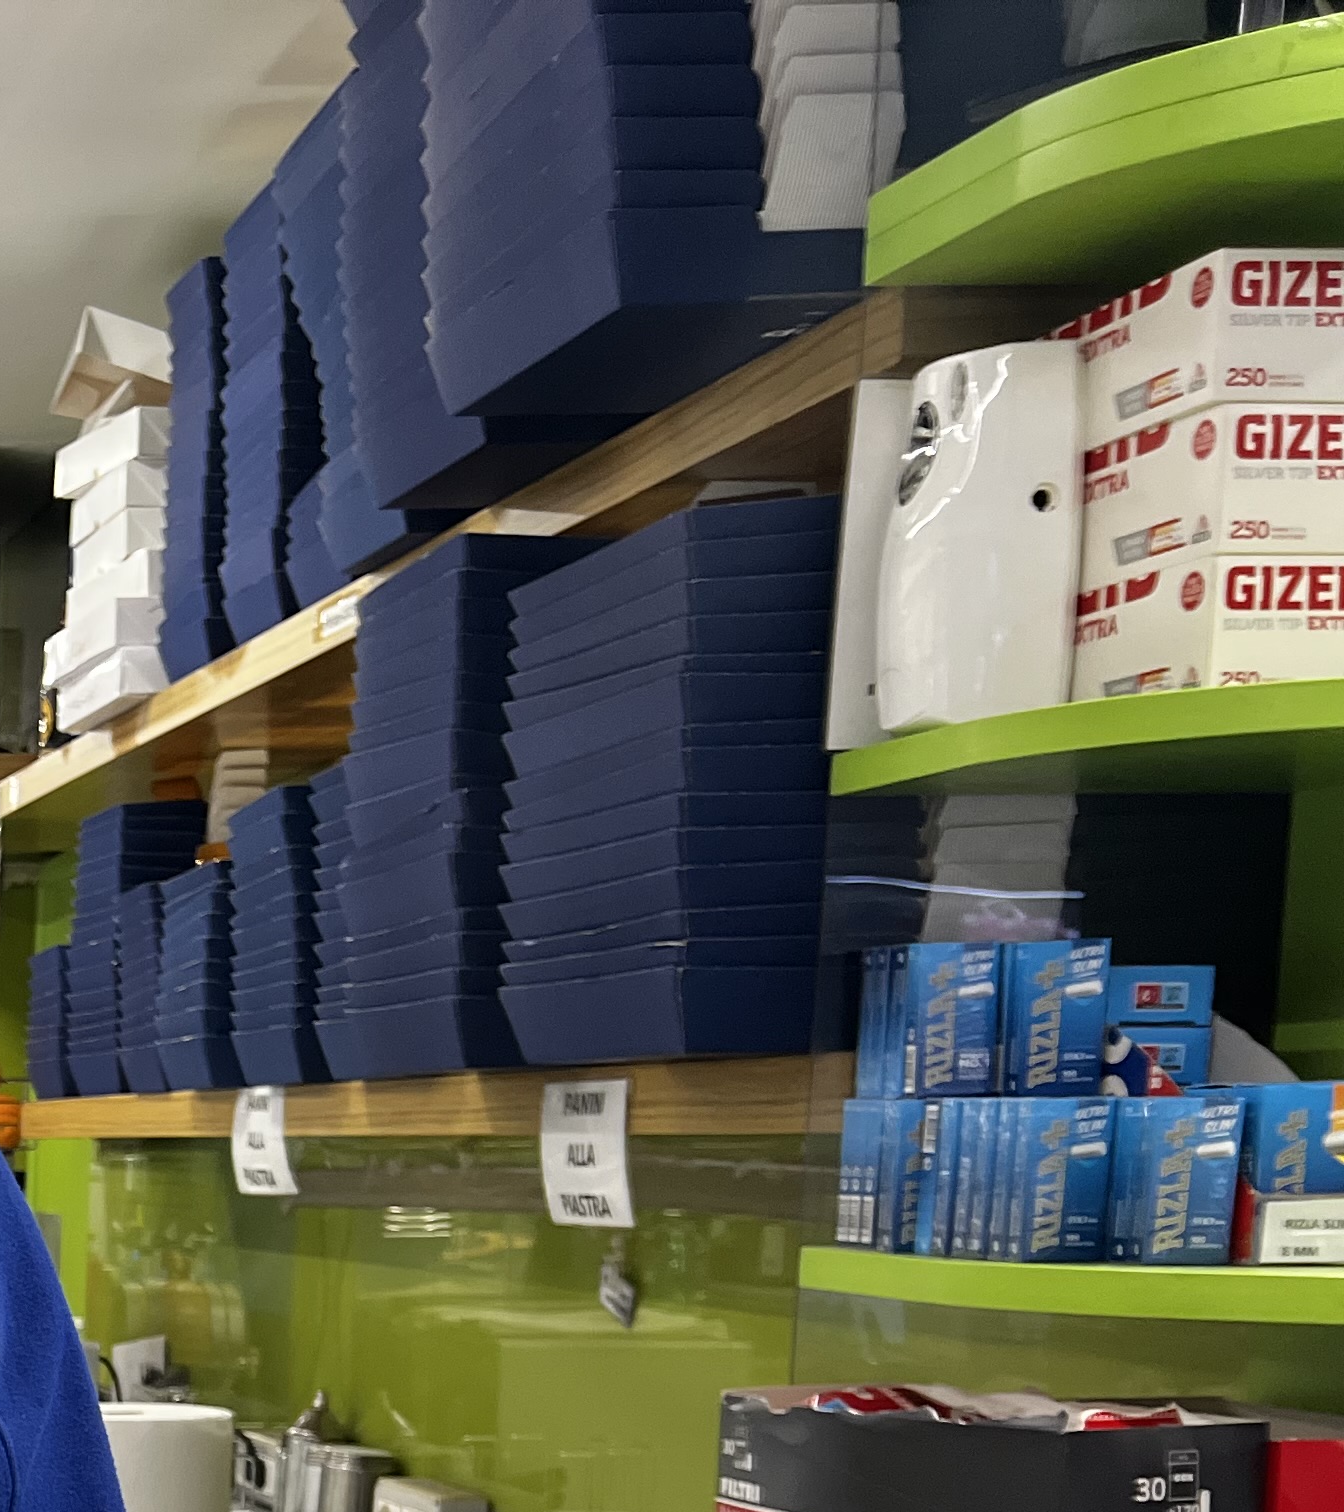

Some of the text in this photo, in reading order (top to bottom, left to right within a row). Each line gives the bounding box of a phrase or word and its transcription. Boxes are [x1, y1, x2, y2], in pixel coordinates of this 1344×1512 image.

[1225, 367, 1267, 387] 250
[1230, 520, 1270, 540] 250
[1225, 566, 1344, 611] GIZE
[1306, 615, 1344, 631] EXT
[567, 1144, 596, 1167] ALLA
[560, 1194, 613, 1218] PIASTRA
[719, 1477, 760, 1504] FILTRI
[1133, 1476, 1167, 1502] 30
